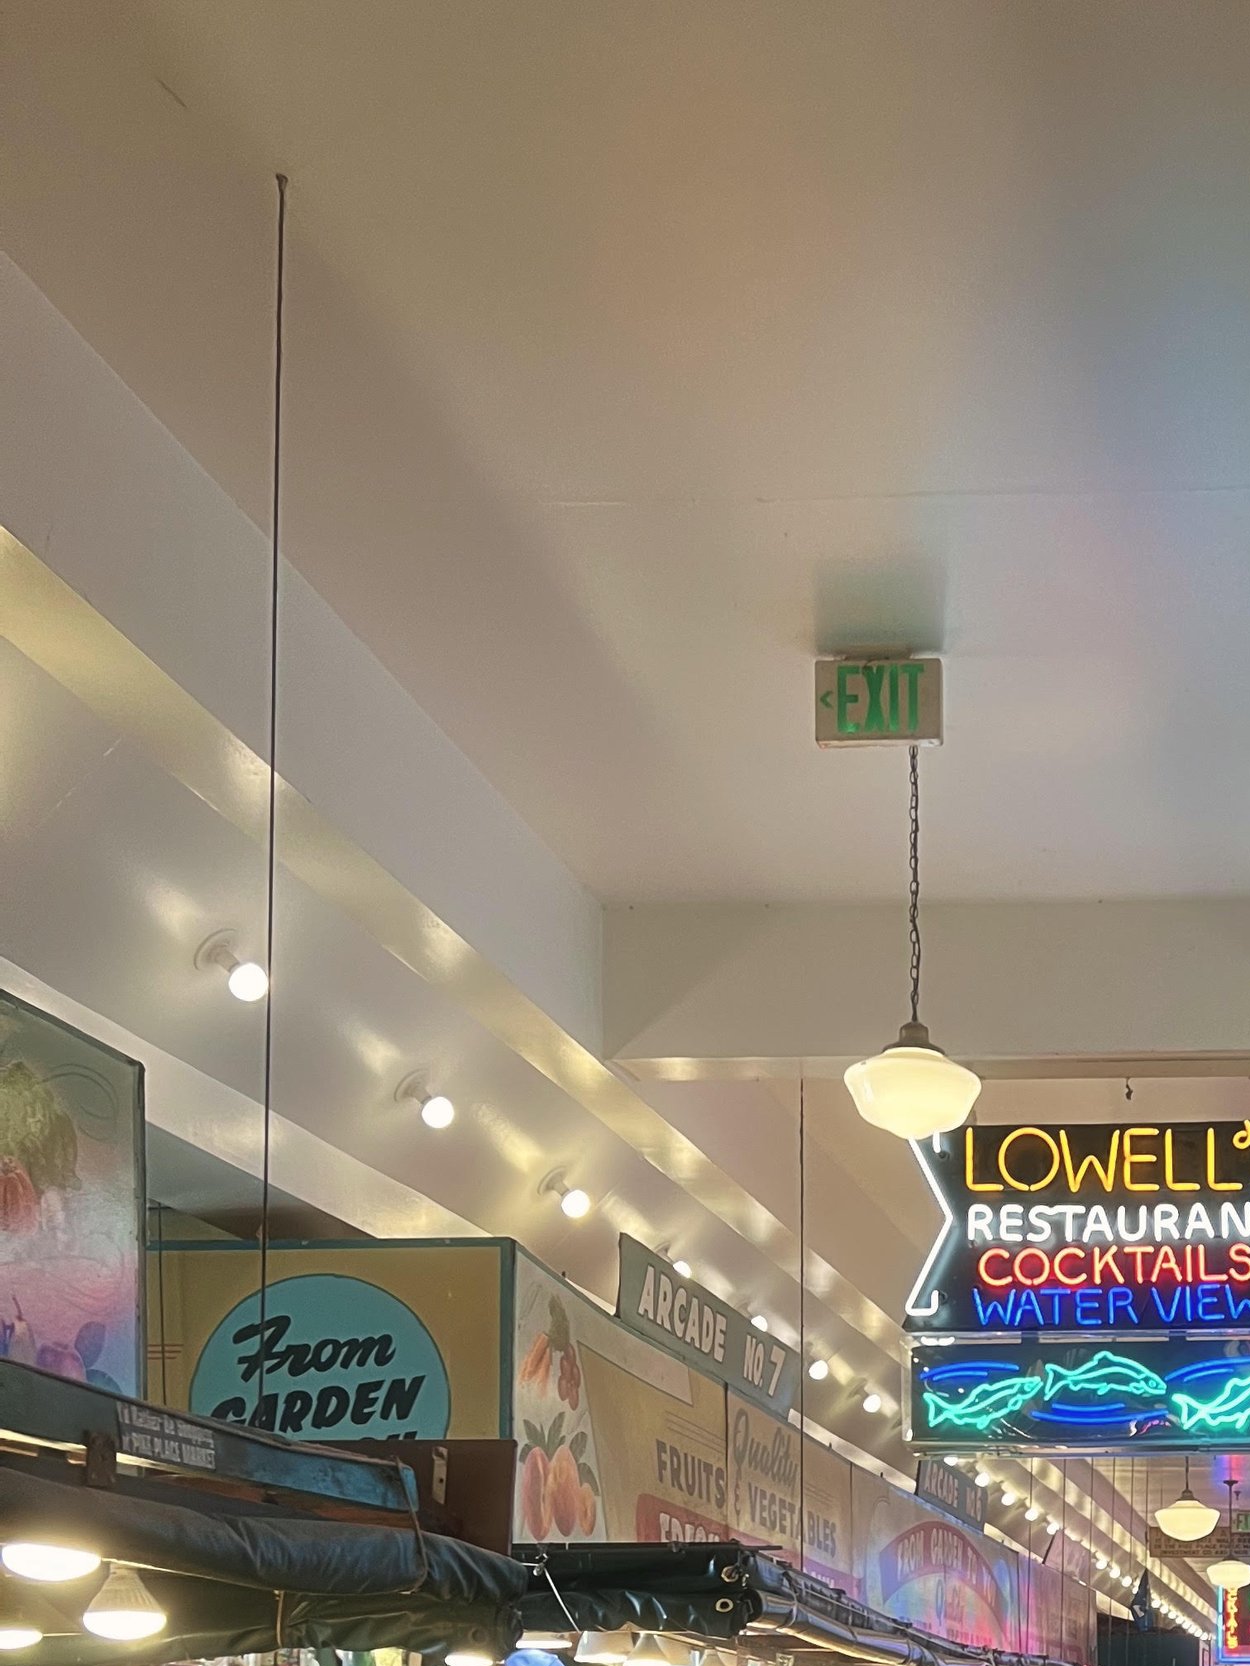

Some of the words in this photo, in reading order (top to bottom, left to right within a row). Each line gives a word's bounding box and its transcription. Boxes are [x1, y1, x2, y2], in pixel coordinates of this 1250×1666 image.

[837, 663, 925, 733] EXIT
[637, 1264, 728, 1364] ARCADE
[743, 1334, 765, 1388] NO.
[768, 1344, 787, 1398] 7
[973, 1287, 1140, 1327] WATER
[232, 1315, 397, 1383] From
[211, 1374, 427, 1434] GARDEN
[733, 1408, 800, 1495] Quality
[924, 1459, 959, 1509] ARCADE
[655, 1438, 726, 1510] FRUITS
[748, 1481, 838, 1558] VEGETABLES
[897, 1529, 925, 1581] FROM
